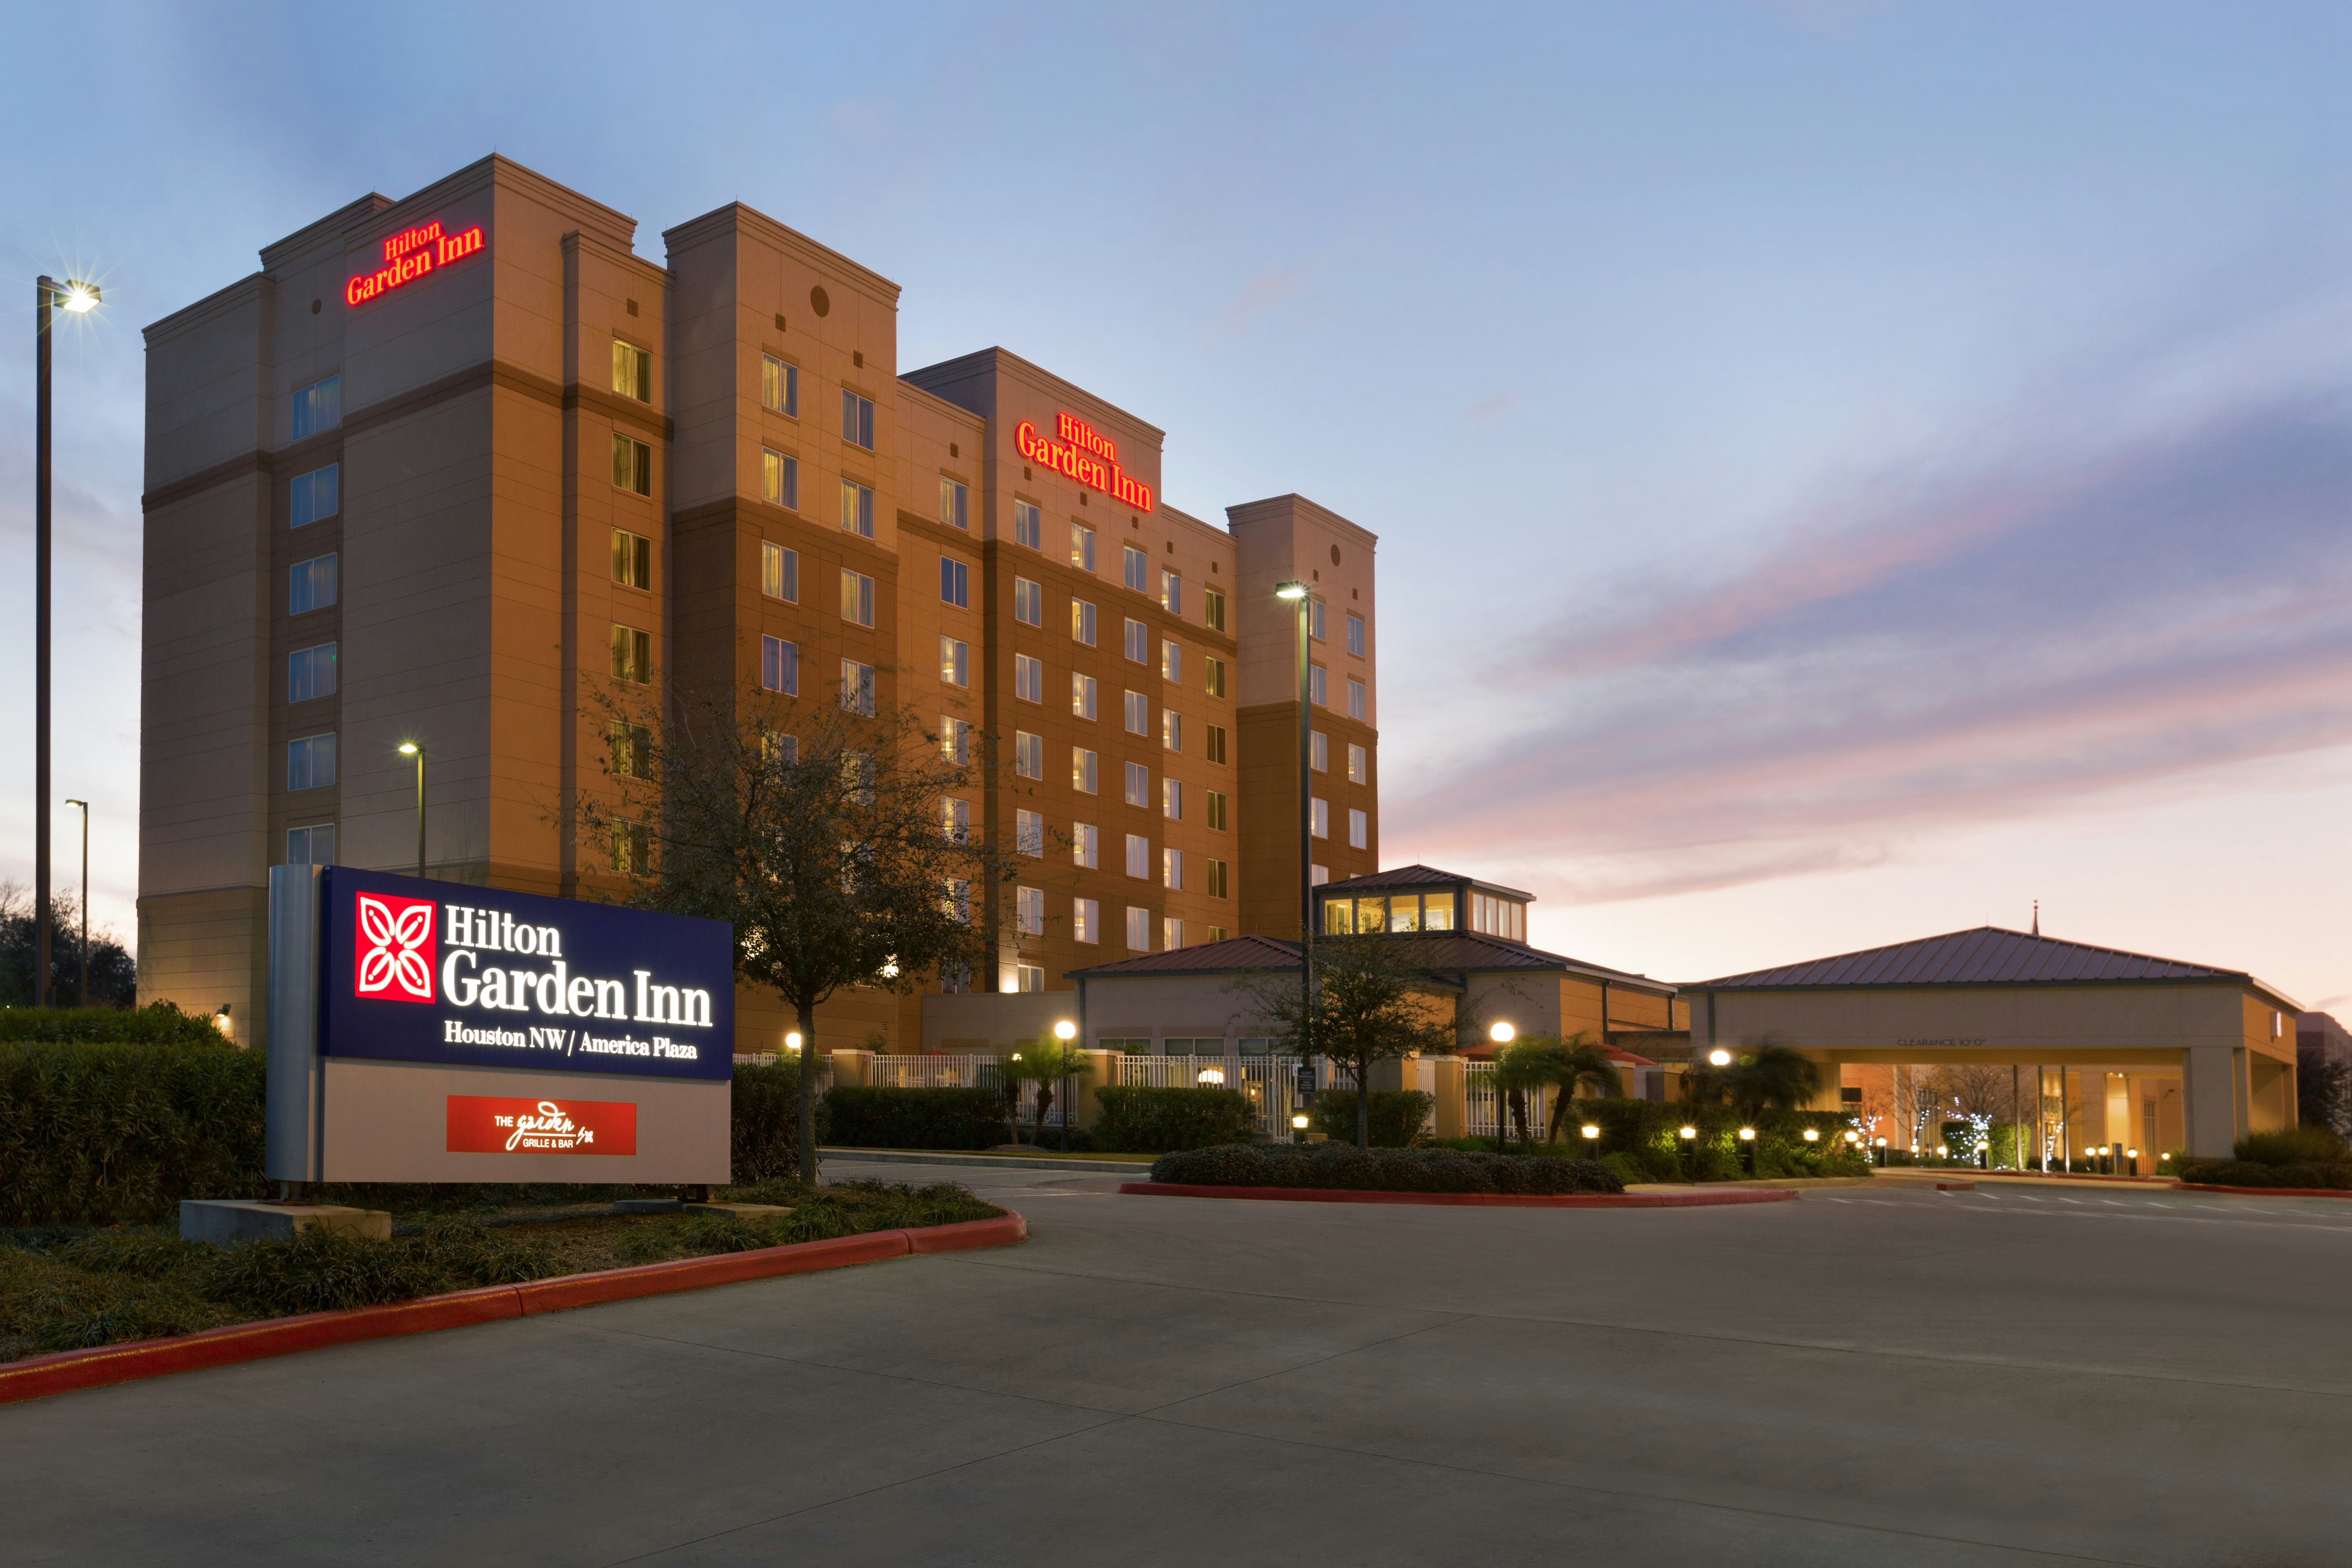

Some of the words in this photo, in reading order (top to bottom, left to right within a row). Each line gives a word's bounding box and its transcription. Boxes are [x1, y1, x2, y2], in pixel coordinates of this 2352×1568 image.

[347, 251, 433, 305] Garden
[437, 227, 484, 266] Inn
[384, 221, 441, 262] Hilton
[1058, 412, 1116, 462] Hilton
[1016, 421, 1108, 492] Garden
[1111, 463, 1152, 512] Inn
[445, 904, 562, 957] Hilton
[443, 949, 628, 1020] Garden
[634, 970, 713, 1027] Inn
[444, 1020, 526, 1047] Houston
[529, 1027, 566, 1050] NW
[579, 1031, 650, 1056] America
[653, 1037, 698, 1059] Plaza
[494, 1116, 513, 1127] THE
[506, 1101, 575, 1151] garden
[523, 1138, 550, 1148] GRILLE
[551, 1140, 557, 1148] &
[558, 1139, 574, 1148] BAR
